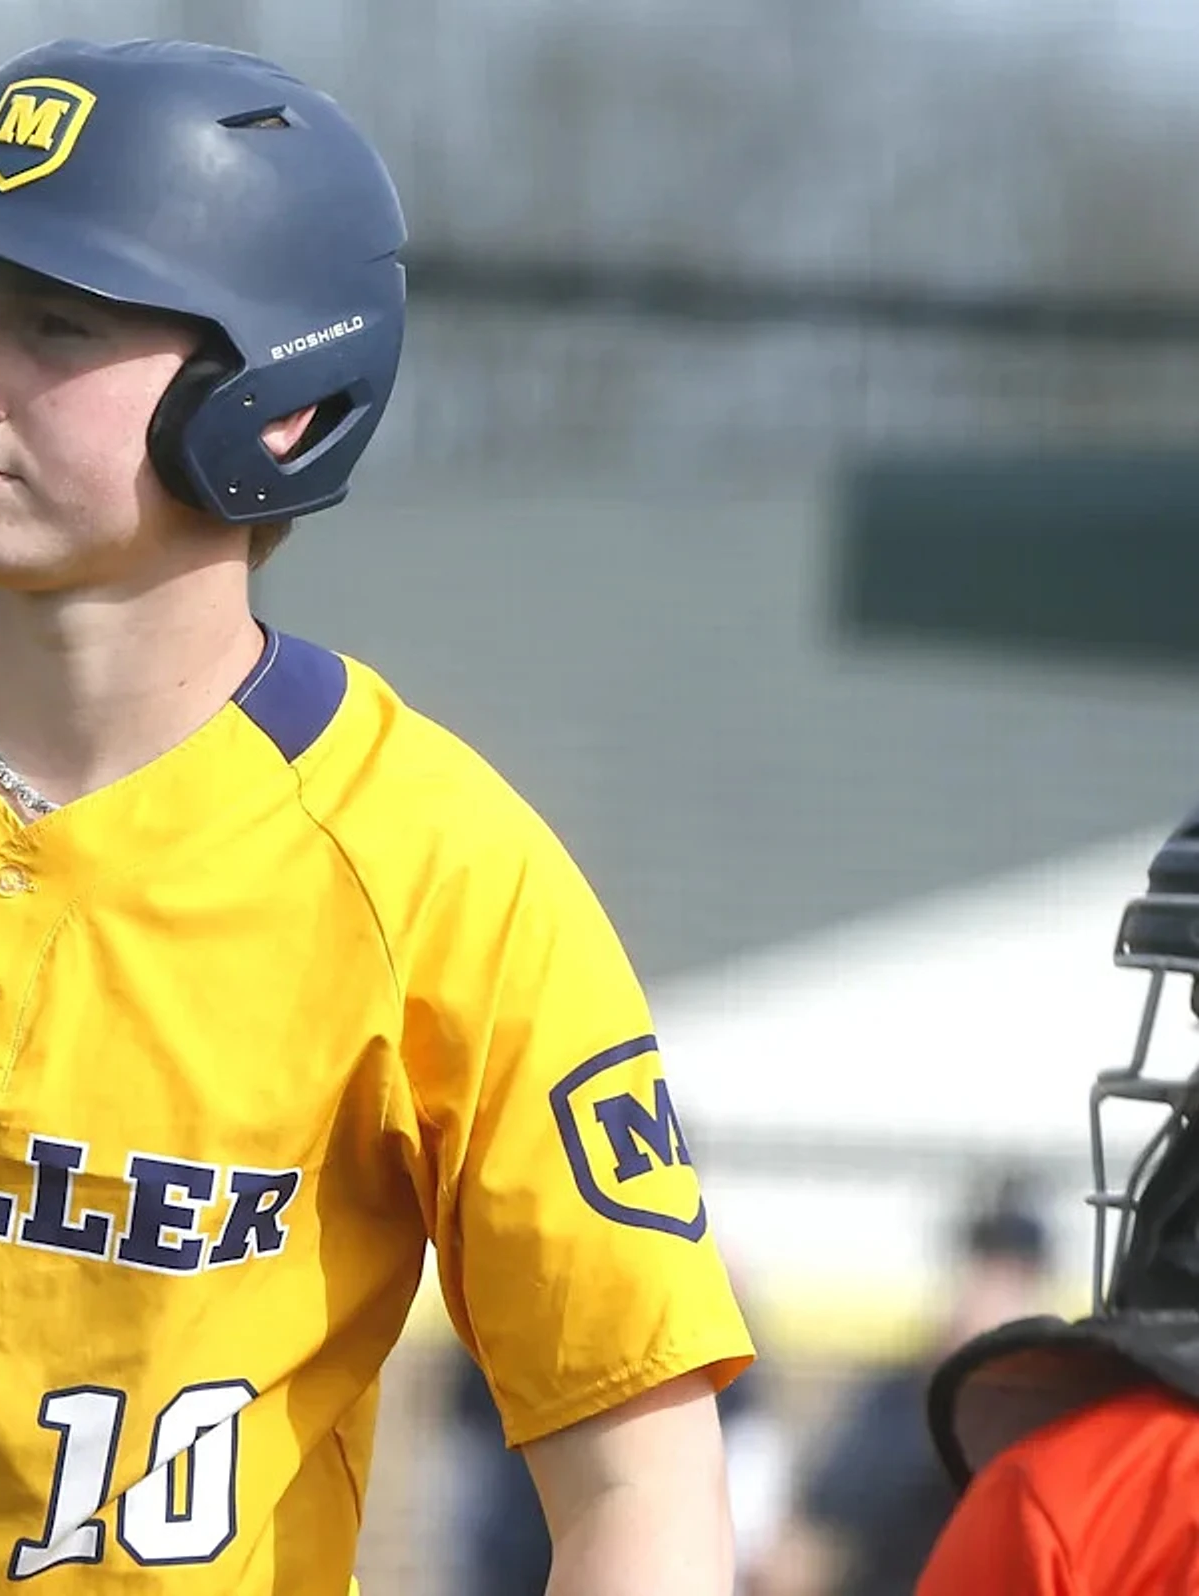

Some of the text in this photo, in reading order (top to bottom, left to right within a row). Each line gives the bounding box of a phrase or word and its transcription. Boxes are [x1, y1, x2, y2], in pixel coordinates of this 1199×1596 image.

[271, 316, 364, 360] EVOSHIELD
[593, 1078, 693, 1184] M
[7, 1378, 259, 1581] 10
